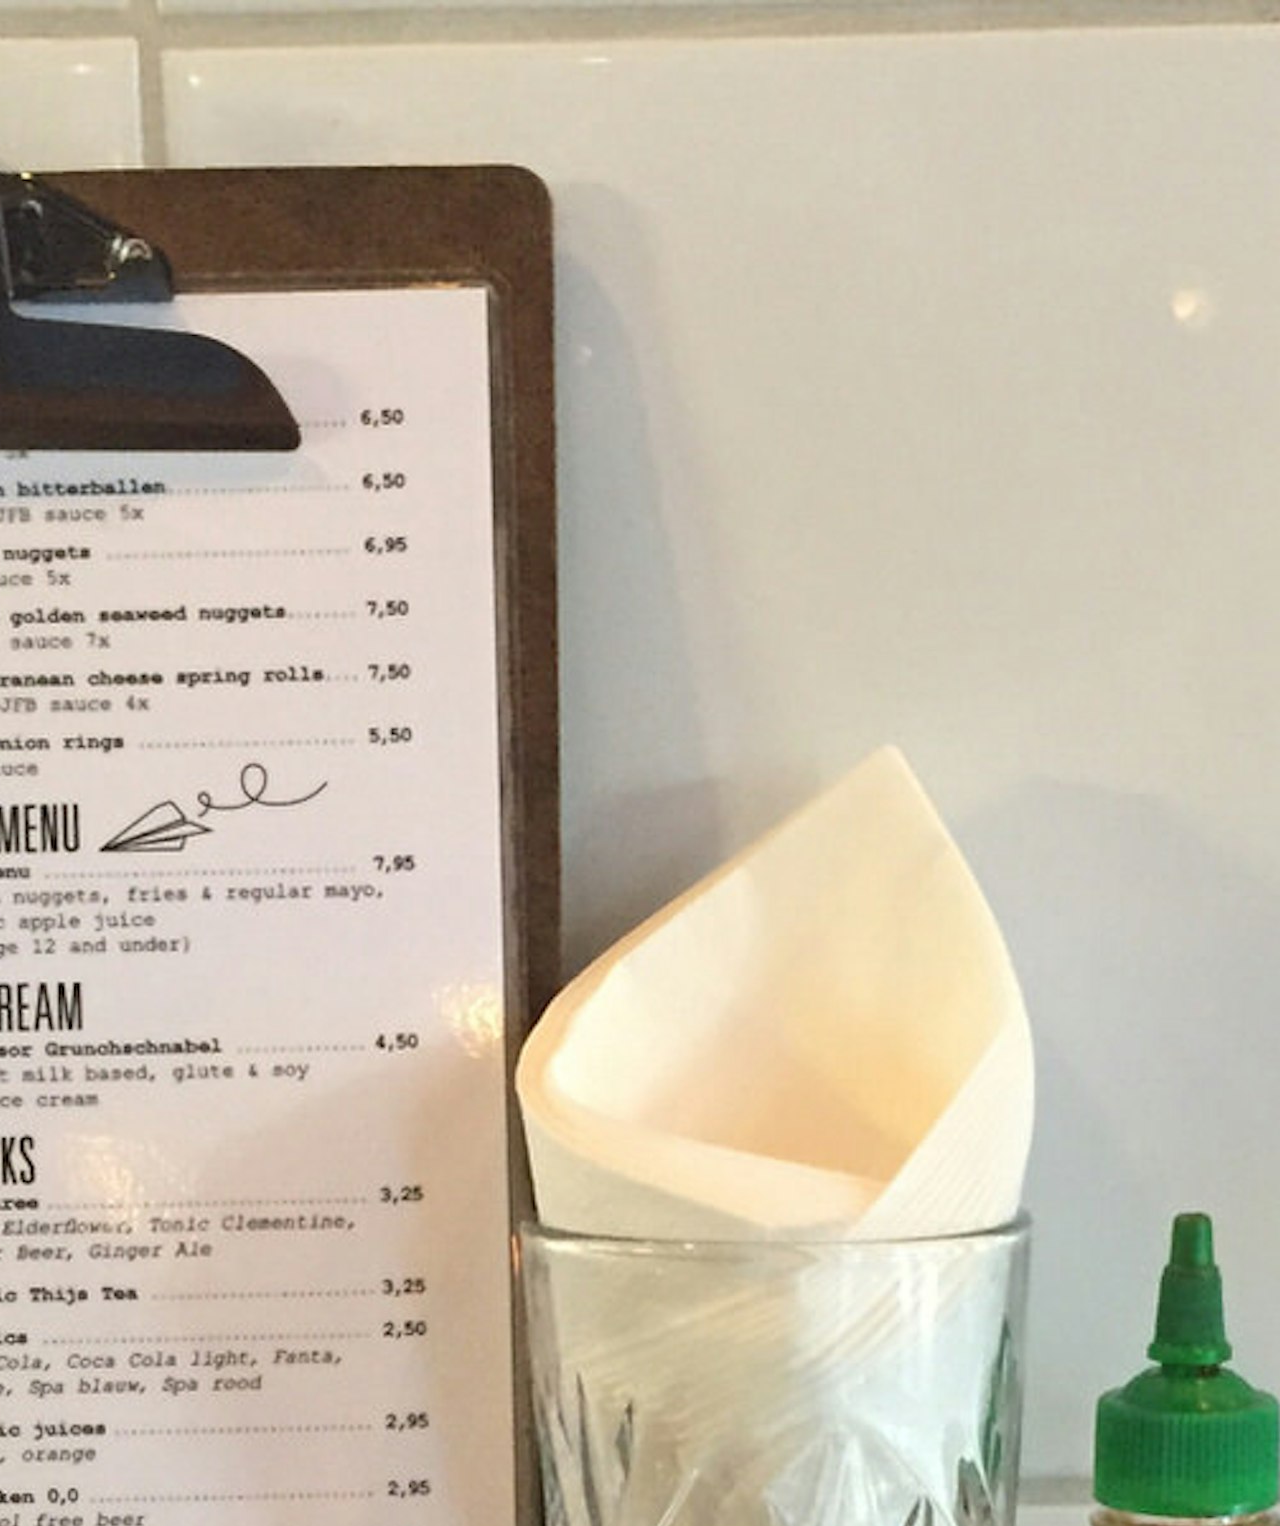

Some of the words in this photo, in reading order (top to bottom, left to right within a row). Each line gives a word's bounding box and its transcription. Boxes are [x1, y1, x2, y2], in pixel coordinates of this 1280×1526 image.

[360, 408, 404, 428] 6,50
[16, 479, 167, 496] bitterballen
[362, 472, 406, 493] 6,50
[2, 544, 92, 564] nuggets
[364, 536, 408, 555] 6,95
[9, 607, 87, 628] golden
[98, 605, 188, 622] seaweed
[198, 603, 287, 624] nuggets
[366, 600, 409, 619] 7,50
[86, 670, 165, 685] cheese
[175, 667, 252, 688] spring
[263, 666, 330, 682] rolls
[368, 663, 412, 683] 7,50
[62, 733, 125, 752] rings
[368, 727, 413, 746] 5,50
[372, 854, 416, 874] 7,95
[375, 1032, 419, 1053] 4,50
[380, 1185, 424, 1205] 3,25
[28, 1285, 89, 1304] Thijs
[100, 1285, 139, 1299] Tea
[382, 1278, 426, 1297] 3,25
[383, 1320, 427, 1340] 2,50
[33, 1420, 107, 1440] juices
[385, 1412, 429, 1432] 2,95
[46, 1488, 80, 1505] 0,0
[388, 1479, 431, 1498] 2,95
